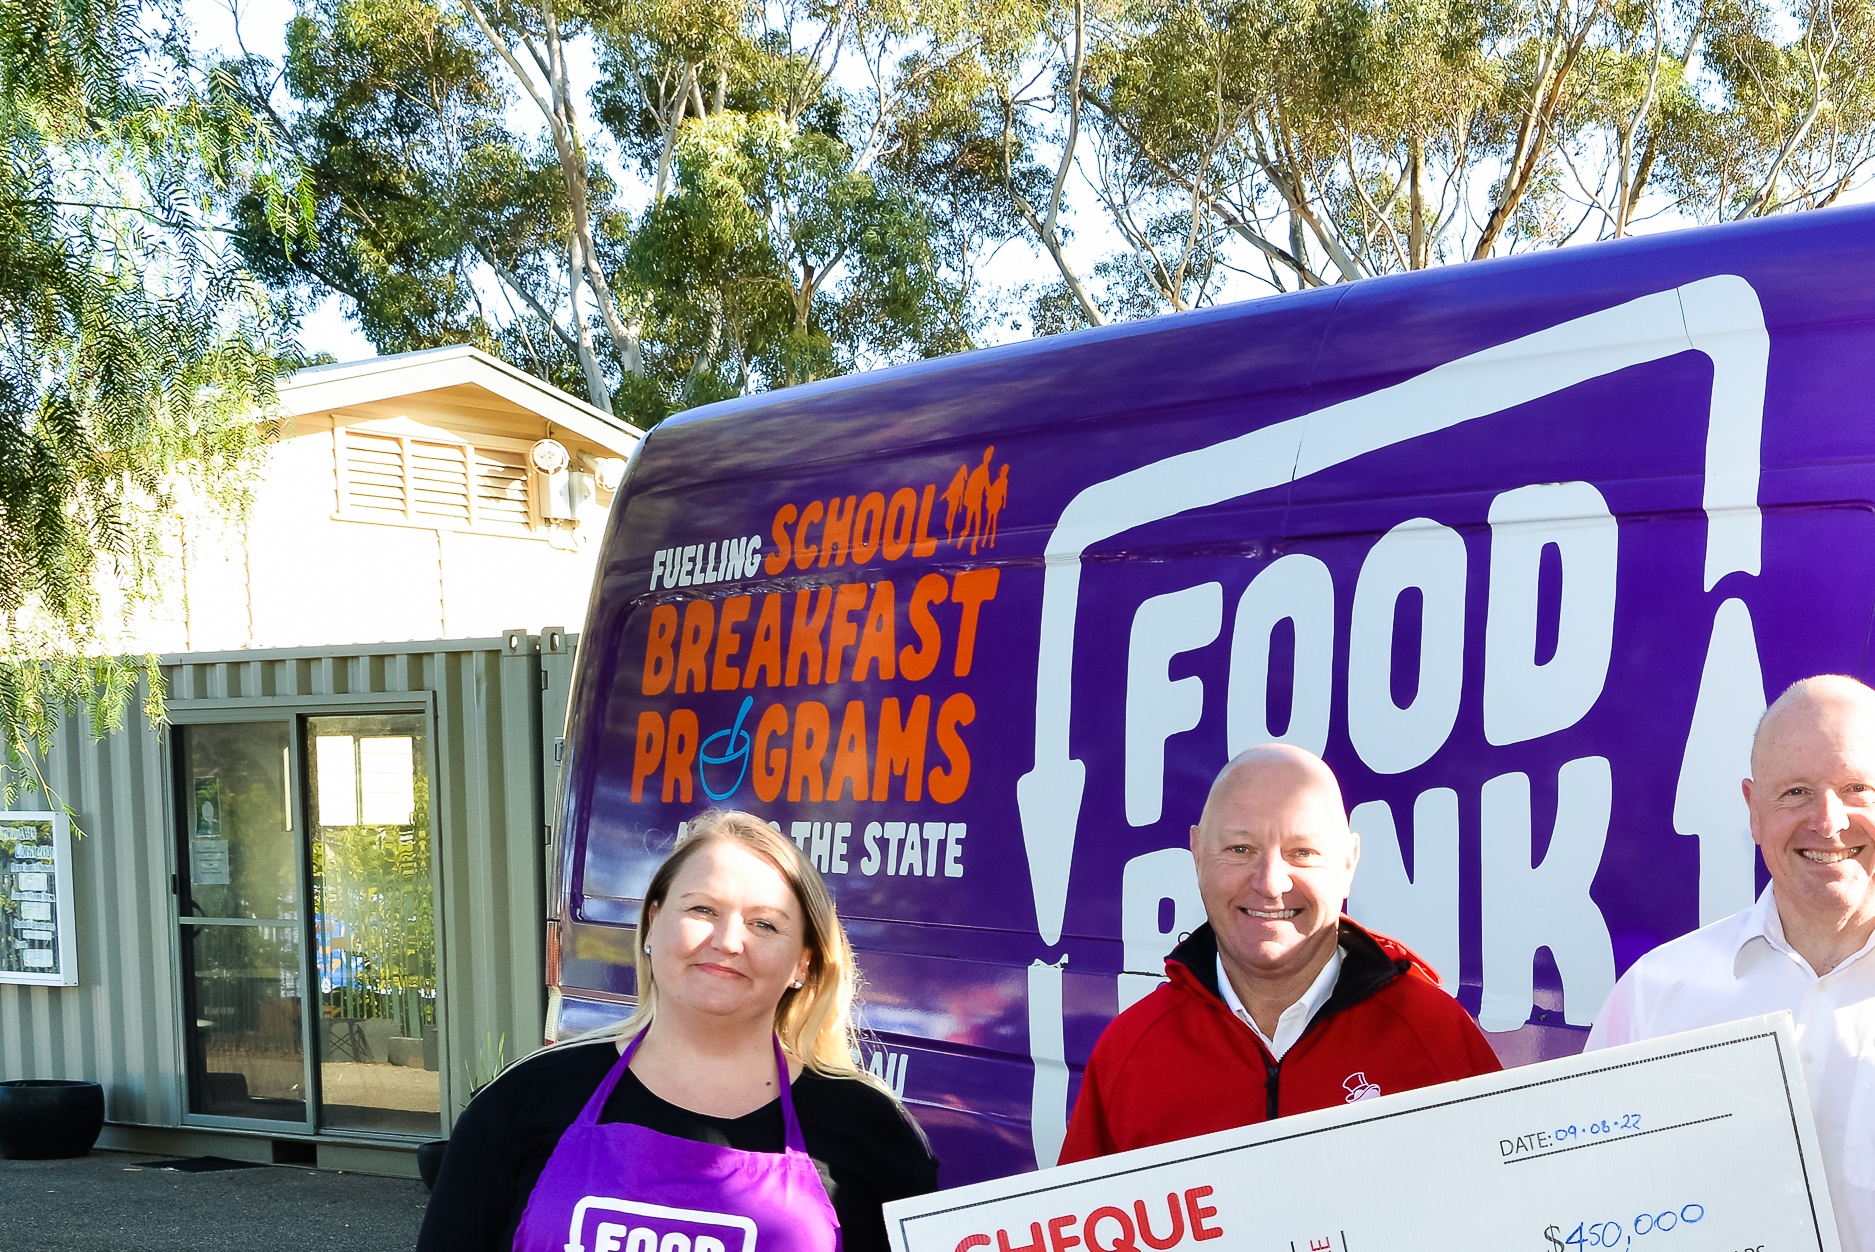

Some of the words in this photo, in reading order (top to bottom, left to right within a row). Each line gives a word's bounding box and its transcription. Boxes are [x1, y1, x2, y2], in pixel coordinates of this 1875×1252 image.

[650, 534, 762, 591] FUELLING
[764, 484, 938, 576] SCHOOL
[641, 567, 1000, 696] BREAKFAST
[1125, 480, 1619, 828] FOOD
[790, 821, 852, 876] THE
[860, 821, 968, 878] STATE
[1117, 755, 1618, 1033] BNK
